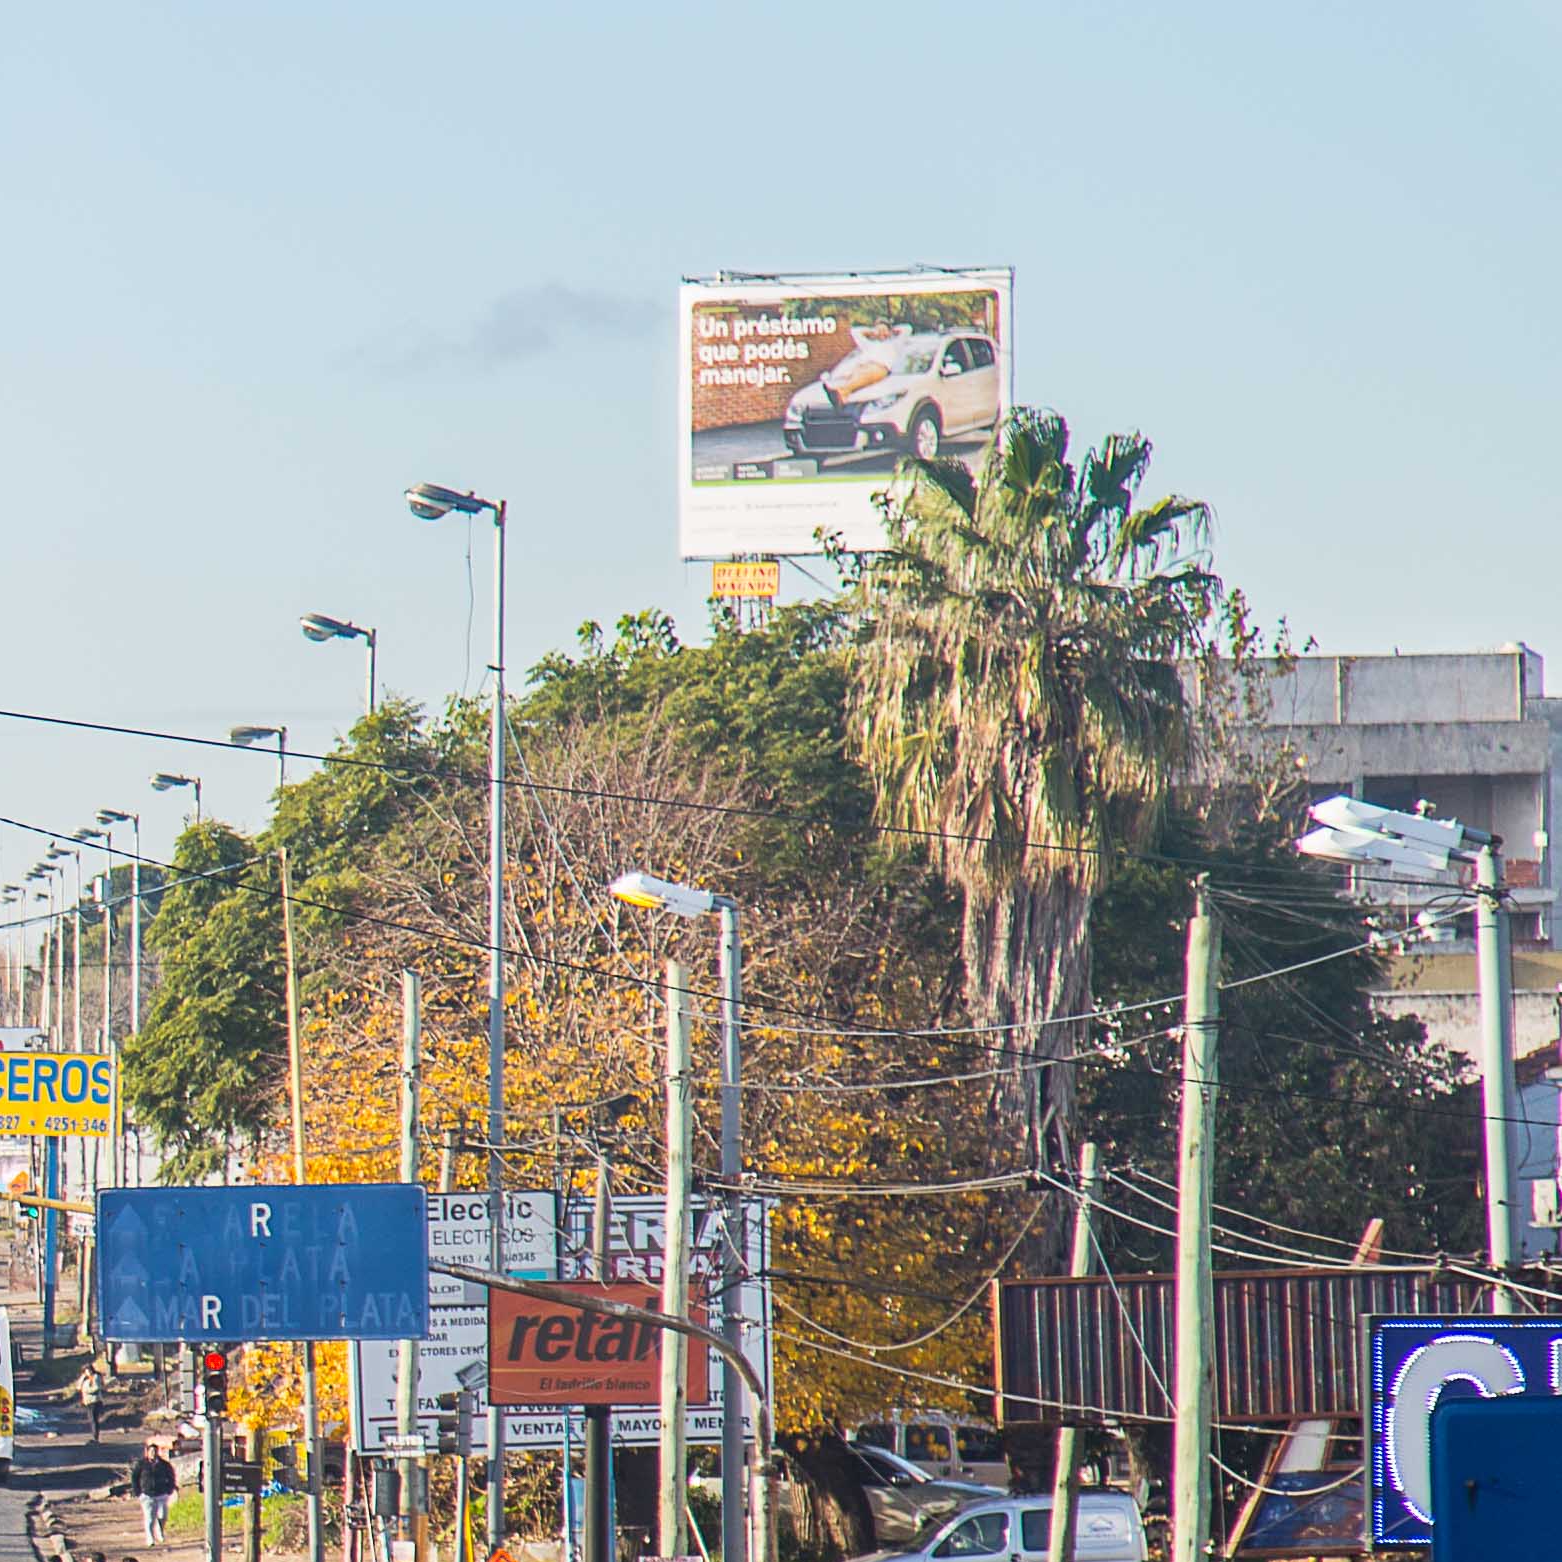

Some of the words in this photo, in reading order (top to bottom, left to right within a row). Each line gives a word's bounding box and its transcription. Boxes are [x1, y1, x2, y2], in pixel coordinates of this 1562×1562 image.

[699, 315, 731, 336] Un
[734, 315, 837, 340] préstamo
[699, 345, 740, 365] que
[744, 338, 810, 363] podés
[699, 364, 792, 387] manejar.
[155, 1294, 223, 1330] MAR
[605, 1377, 650, 1390] blanco
[618, 1417, 662, 1432] MAYO
